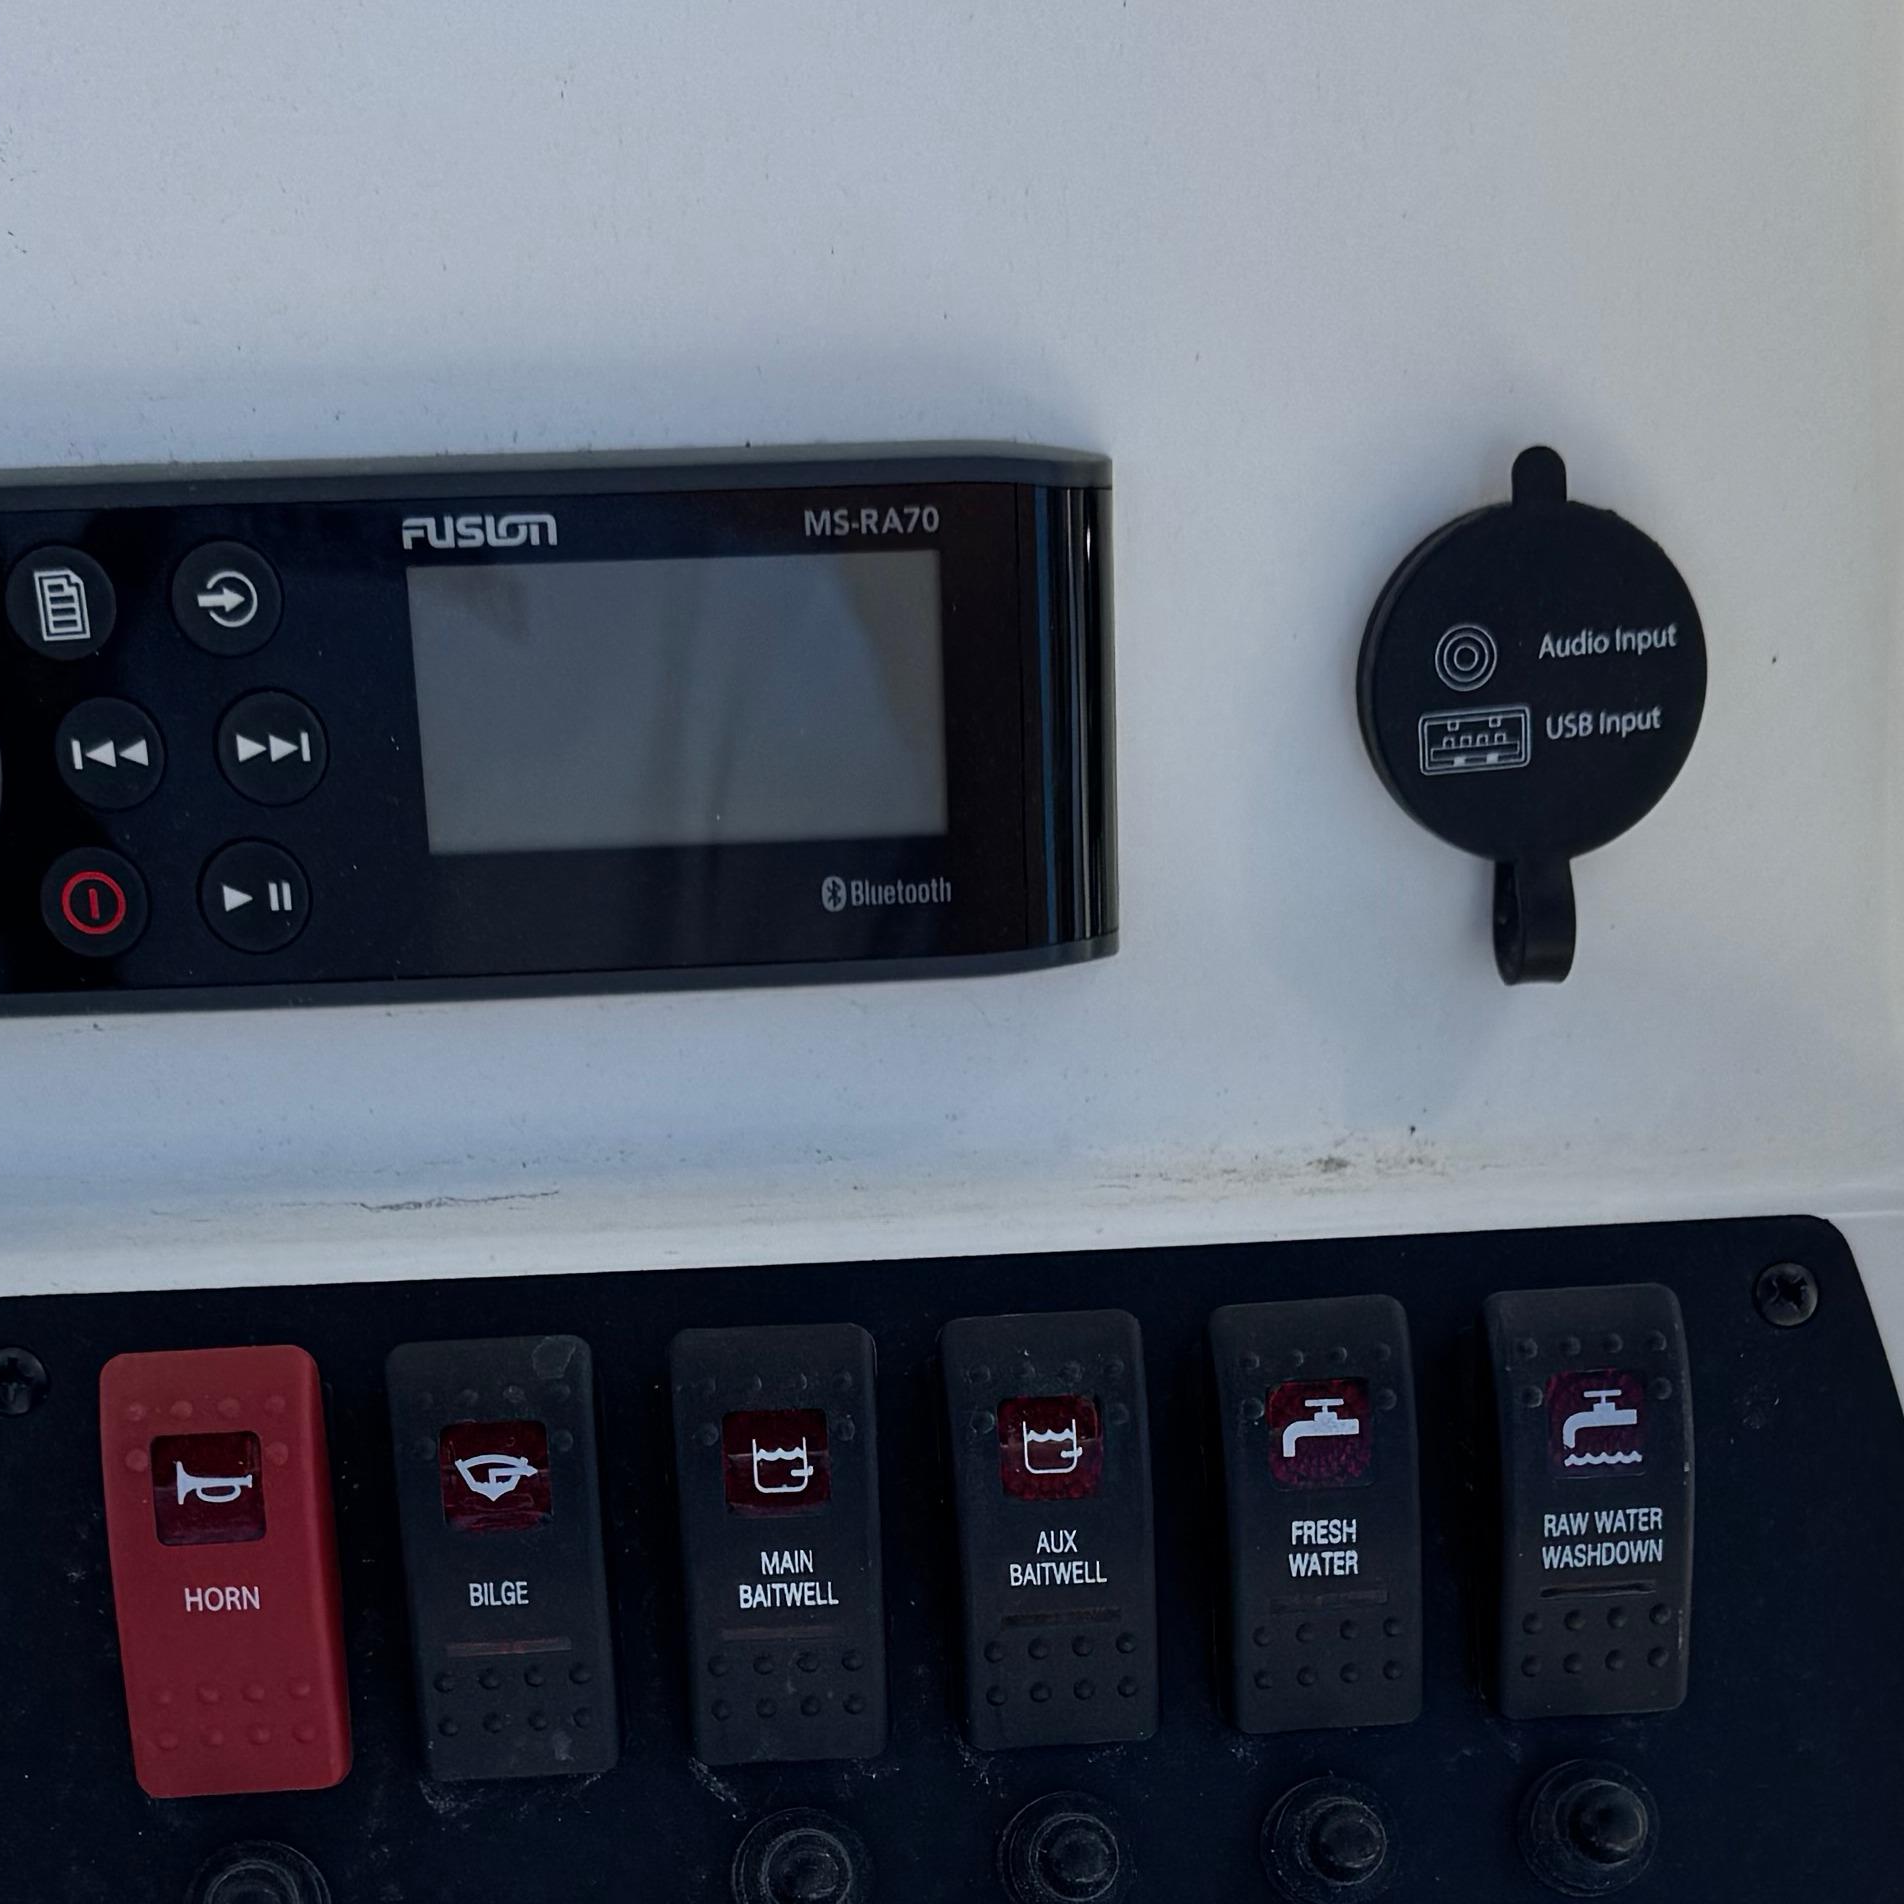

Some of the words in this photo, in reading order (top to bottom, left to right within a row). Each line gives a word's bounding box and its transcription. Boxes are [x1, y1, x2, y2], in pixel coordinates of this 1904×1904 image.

[804, 505, 940, 537] MS-RA70
[1538, 629, 1610, 660] Audio
[1615, 623, 1677, 656] Input
[1546, 711, 1594, 740] USB
[1599, 706, 1661, 738] Input
[850, 876, 952, 907] Bluetooth
[1291, 1518, 1357, 1546] FRESH
[1543, 1511, 1590, 1538] RAW
[1593, 1507, 1663, 1534] WATER
[1036, 1529, 1078, 1554] AUX
[1541, 1538, 1663, 1570] WASHDOWN
[760, 1549, 814, 1576] MAIN
[1009, 1560, 1108, 1587] BAITWELL
[1288, 1549, 1359, 1578] WATER
[184, 1585, 260, 1612] HORN
[468, 1580, 530, 1607] BILGE
[739, 1581, 840, 1609] BAITWELL
